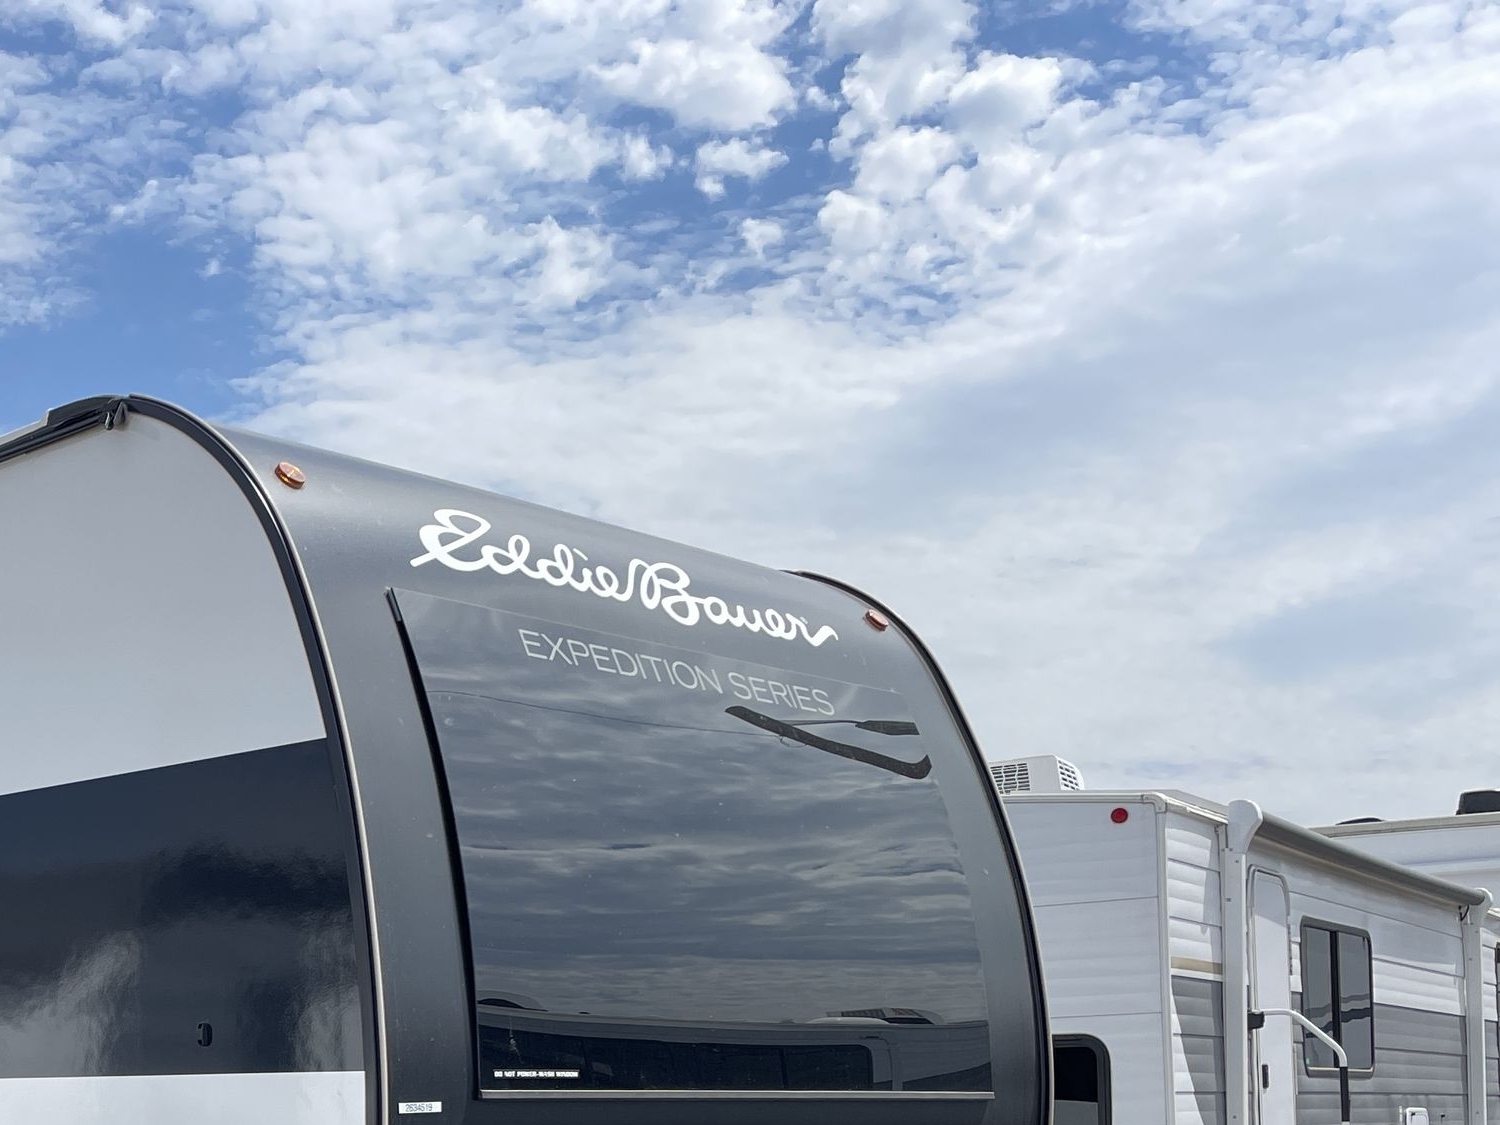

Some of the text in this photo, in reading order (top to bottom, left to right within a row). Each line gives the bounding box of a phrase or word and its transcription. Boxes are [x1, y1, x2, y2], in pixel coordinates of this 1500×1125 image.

[409, 507, 840, 648] Eddie Bauer
[517, 628, 836, 717] EXPEDITION SERIES
